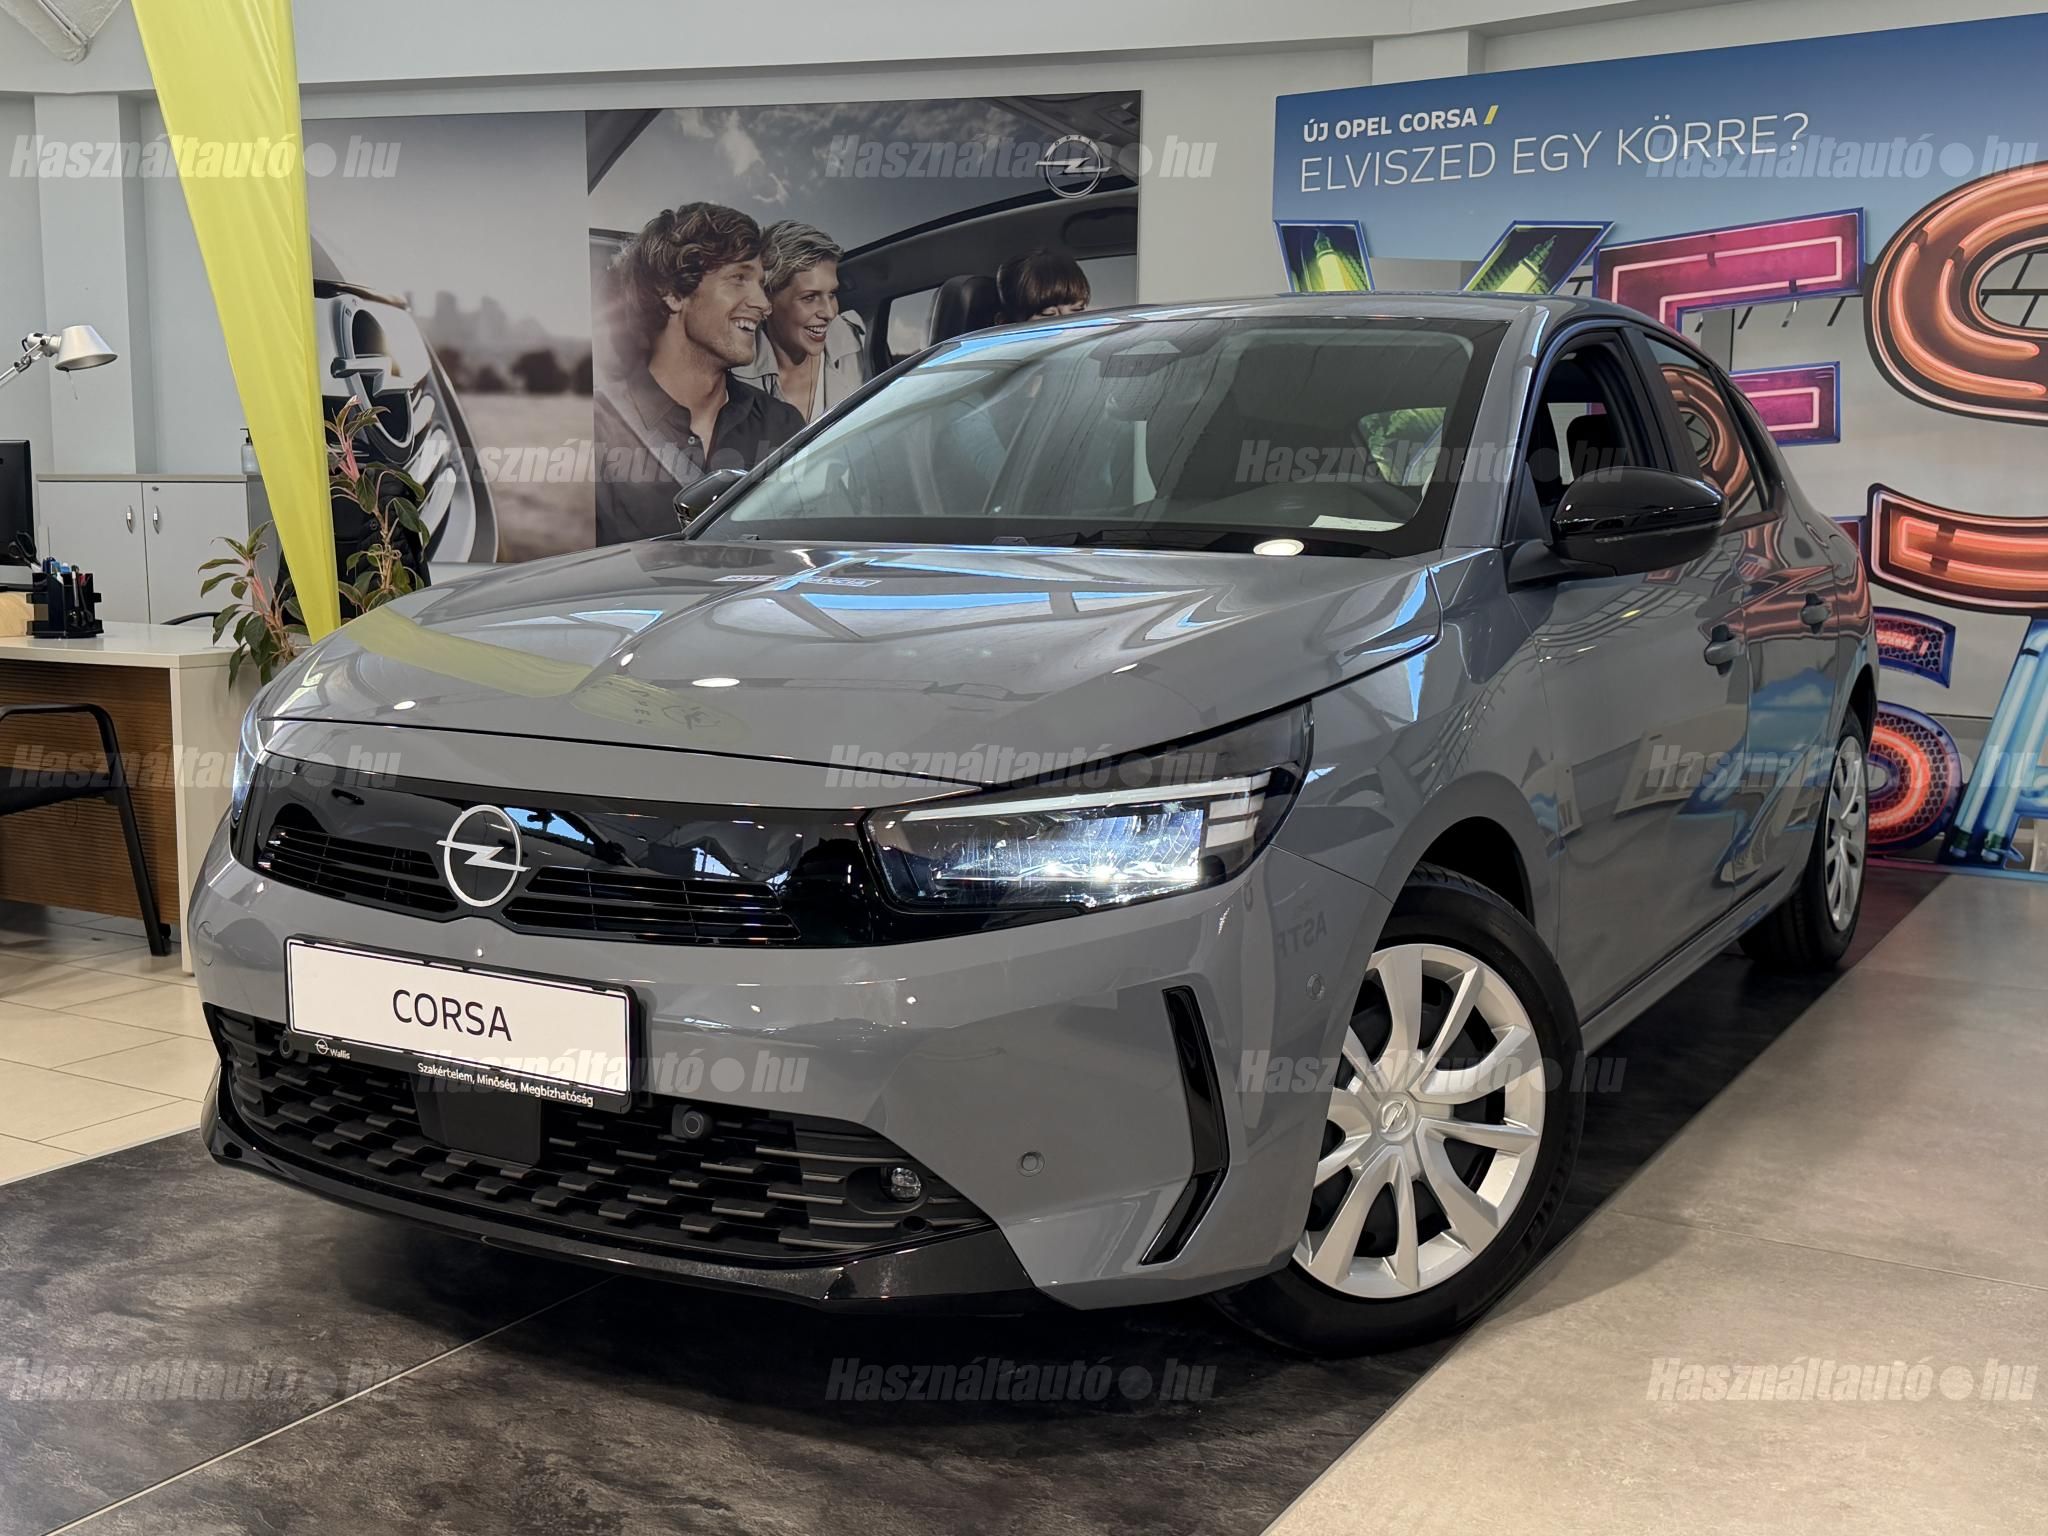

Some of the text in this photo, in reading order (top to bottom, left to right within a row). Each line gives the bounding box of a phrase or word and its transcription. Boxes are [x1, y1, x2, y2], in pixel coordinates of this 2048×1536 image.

[1303, 107, 1478, 143] ÚJ OPEL CORSA
[1301, 112, 1809, 192] ELVISZED EGY KÖRRE?
[392, 989, 512, 1041] CORSA
[330, 1049, 351, 1060] Wallis
[417, 1062, 475, 1084] Szakértelem,
[520, 1082, 594, 1108] Megbízhatóság
